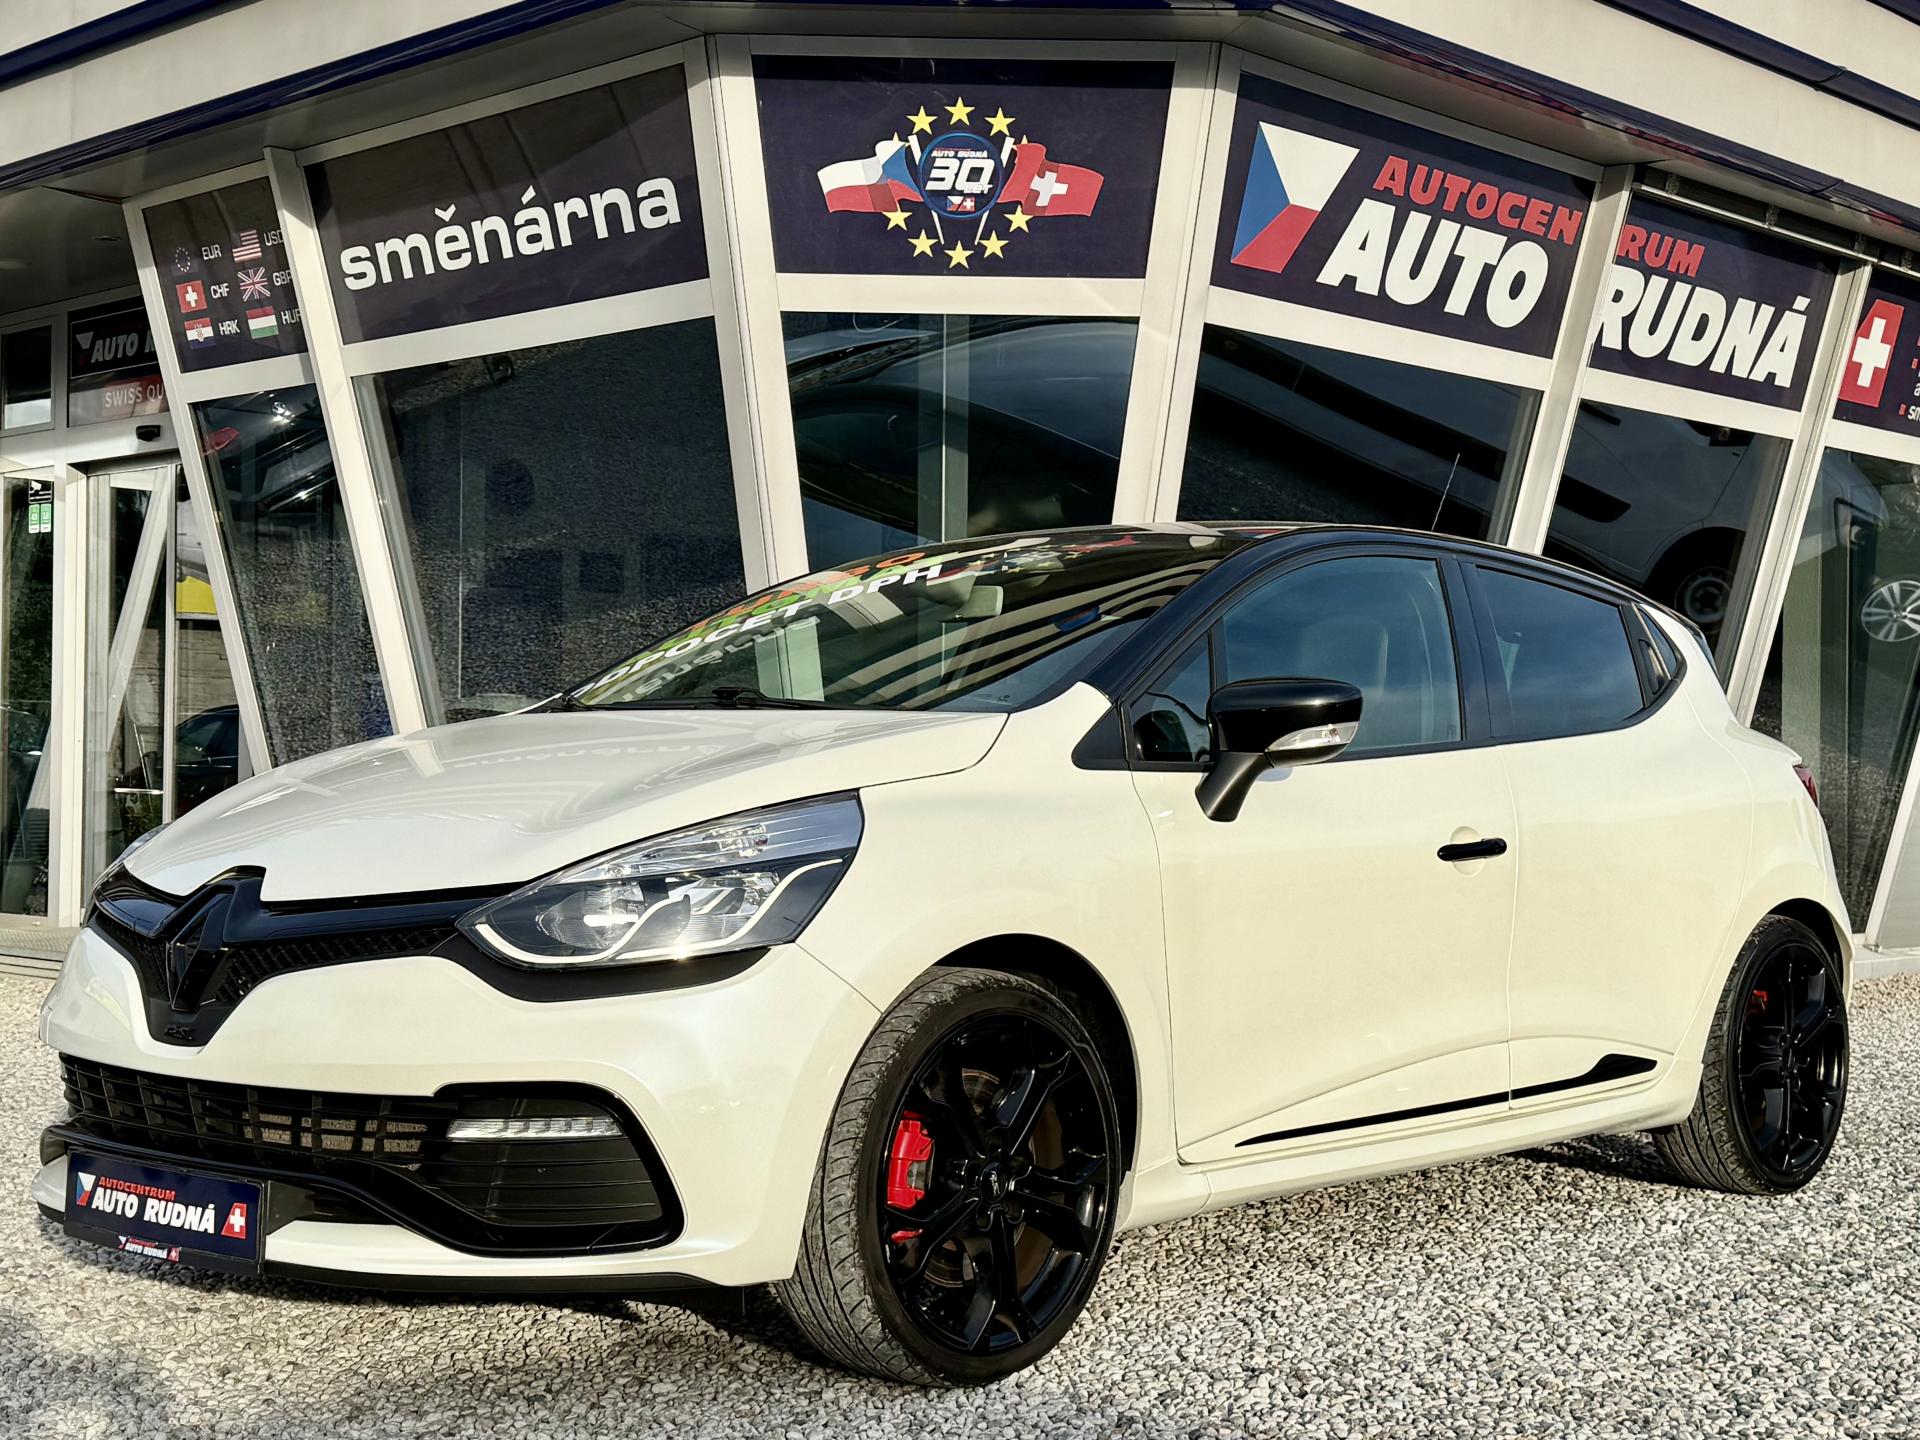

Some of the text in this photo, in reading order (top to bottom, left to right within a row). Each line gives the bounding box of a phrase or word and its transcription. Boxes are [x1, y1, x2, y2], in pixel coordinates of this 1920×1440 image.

[925, 158, 995, 191] 30
[340, 176, 682, 290] směnárna
[202, 244, 222, 260] EUR
[210, 283, 230, 299] CHF
[1315, 197, 1811, 388] AUTO RUDNÁ
[218, 319, 241, 336] HRK
[91, 332, 139, 363] AUTO
[104, 386, 142, 407] SWISS
[827, 564, 943, 605] DPH
[99, 1176, 176, 1201] AUTOCENTRUM
[91, 1187, 215, 1234] AUTO RUDNÁ
